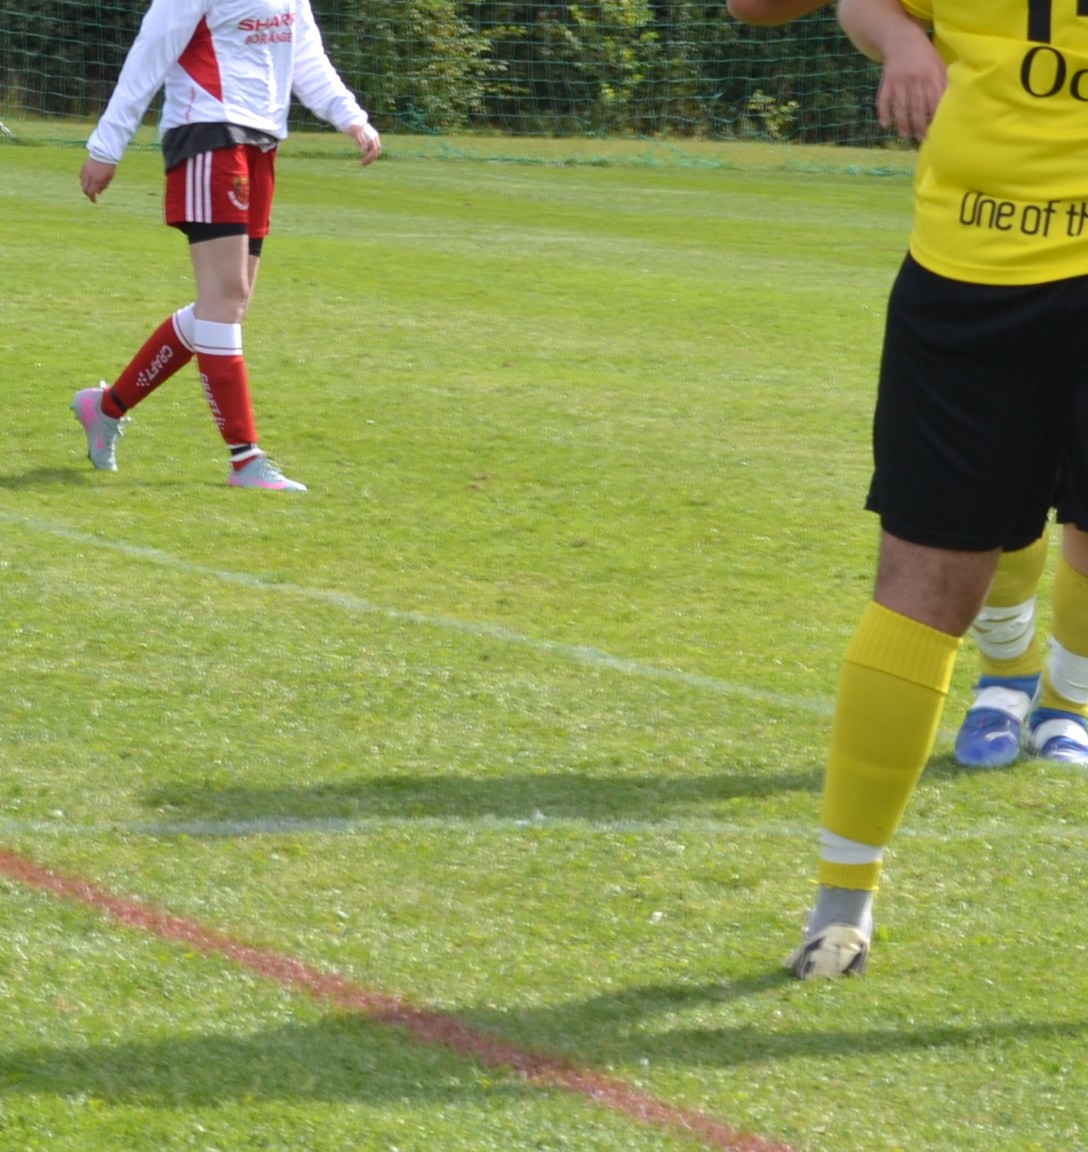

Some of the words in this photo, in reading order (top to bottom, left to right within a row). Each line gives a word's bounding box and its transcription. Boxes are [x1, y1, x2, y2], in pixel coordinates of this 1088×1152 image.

[959, 190, 1016, 231] One
[1020, 199, 1062, 238] of
[145, 345, 173, 381] CRAFT
